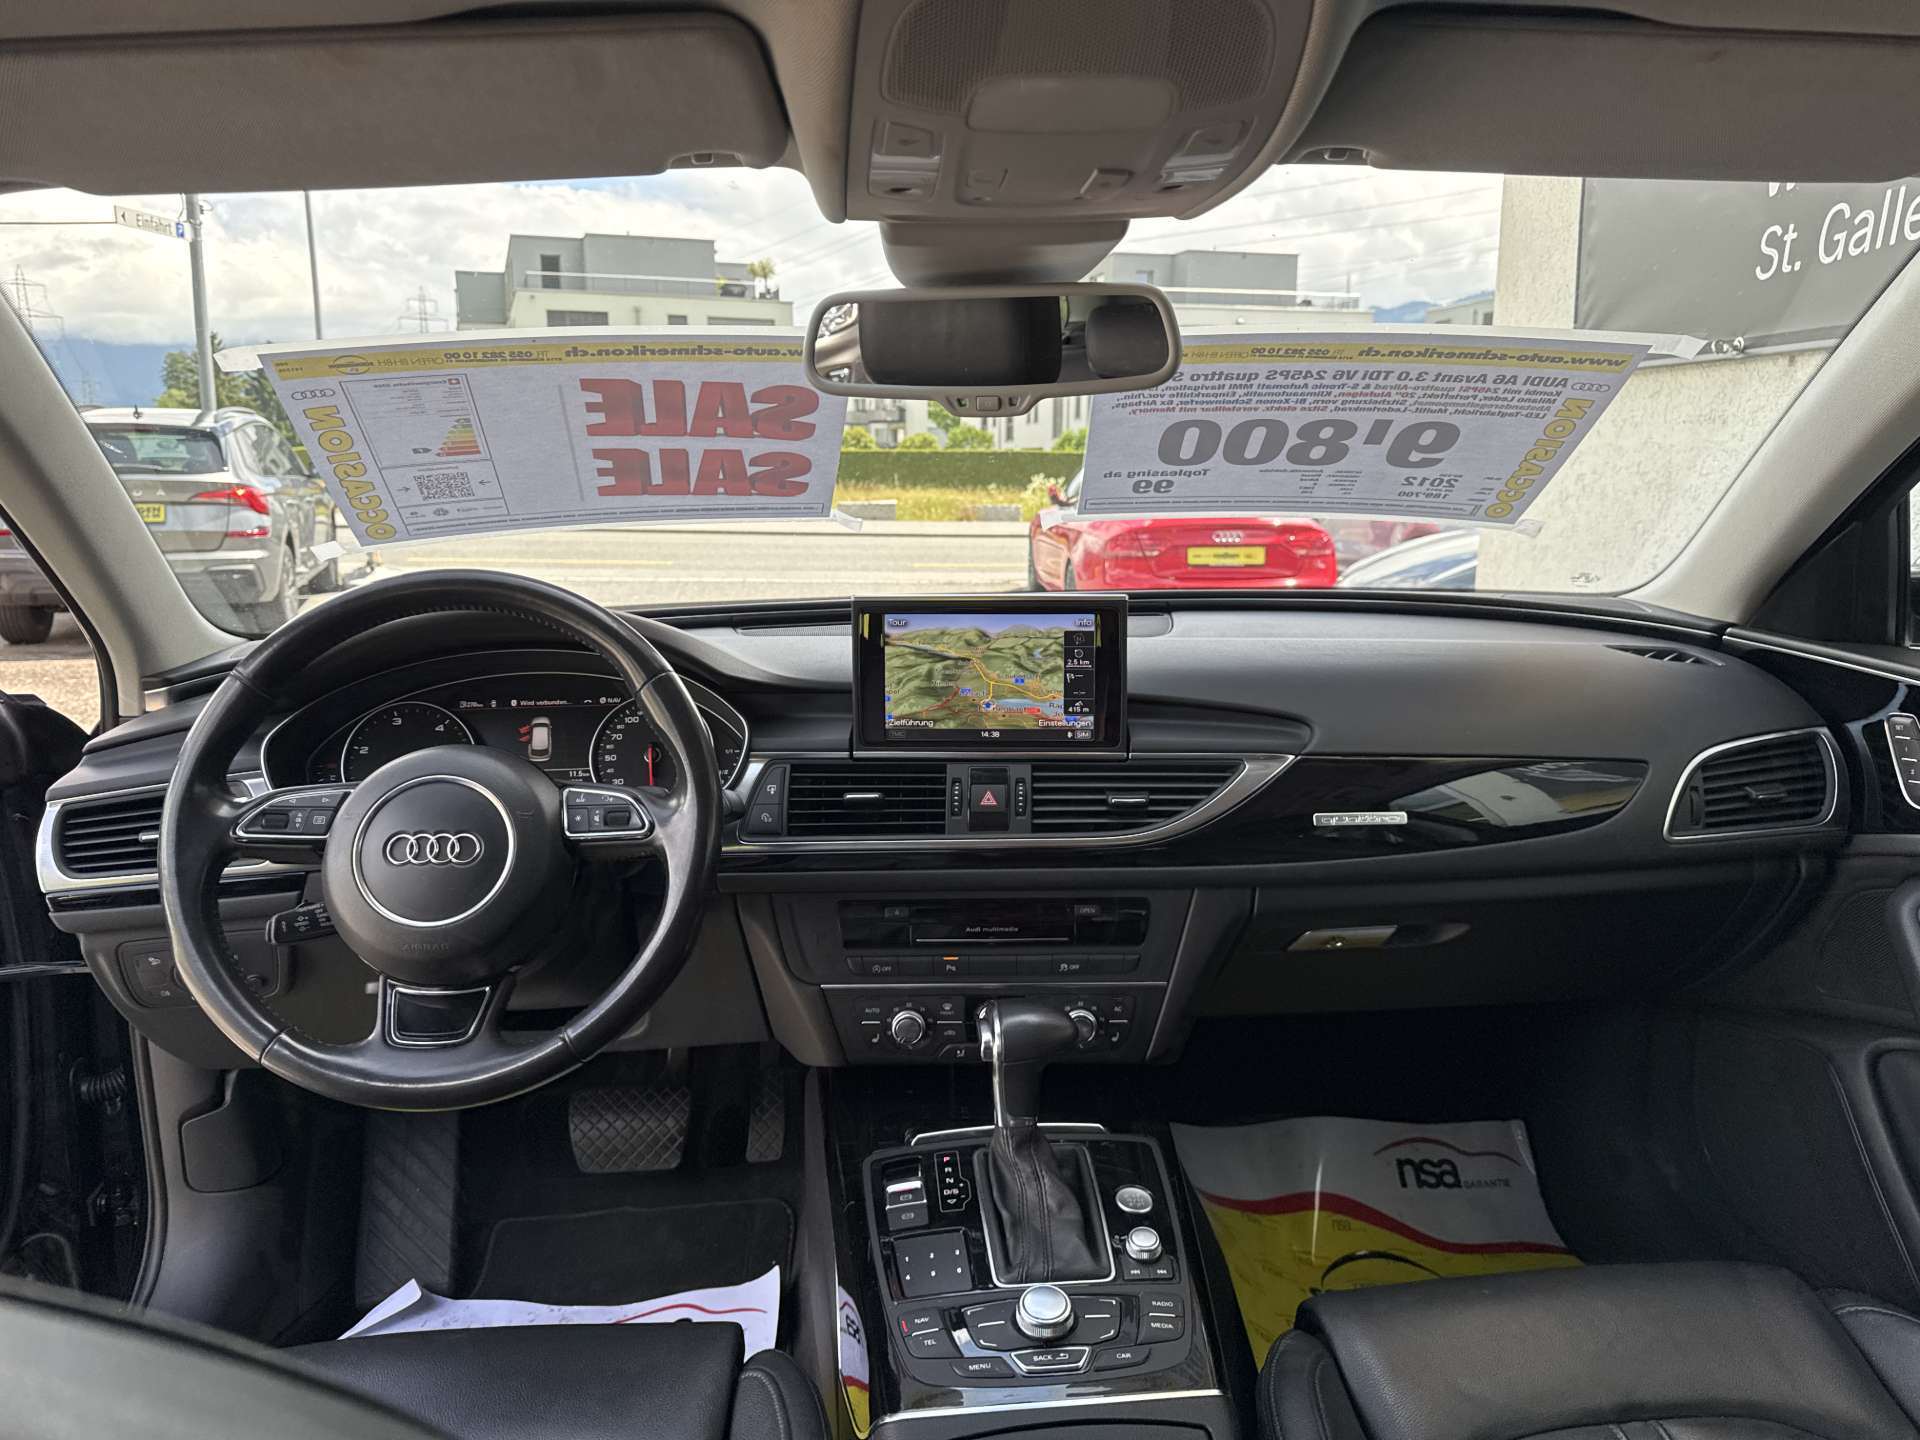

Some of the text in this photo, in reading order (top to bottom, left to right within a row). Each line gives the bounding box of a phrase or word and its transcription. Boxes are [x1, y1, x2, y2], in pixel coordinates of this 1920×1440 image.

[136, 213, 173, 235] Einfahrt
[1755, 224, 1802, 281] St.
[1067, 658, 1078, 666] 2.5
[392, 717, 402, 726] 3
[624, 716, 640, 724] 100
[889, 718, 934, 728] Zielführung
[435, 724, 444, 732] 4
[1038, 720, 1092, 729] Einstellungen
[360, 746, 369, 754] 2
[604, 754, 616, 762] 50
[612, 778, 624, 786] 30
[1396, 1157, 1462, 1190] nsa
[1152, 1300, 1174, 1308] RADIO
[914, 1316, 930, 1324] NAV
[1032, 1354, 1052, 1362] BACK
[968, 1362, 992, 1371] MENU
